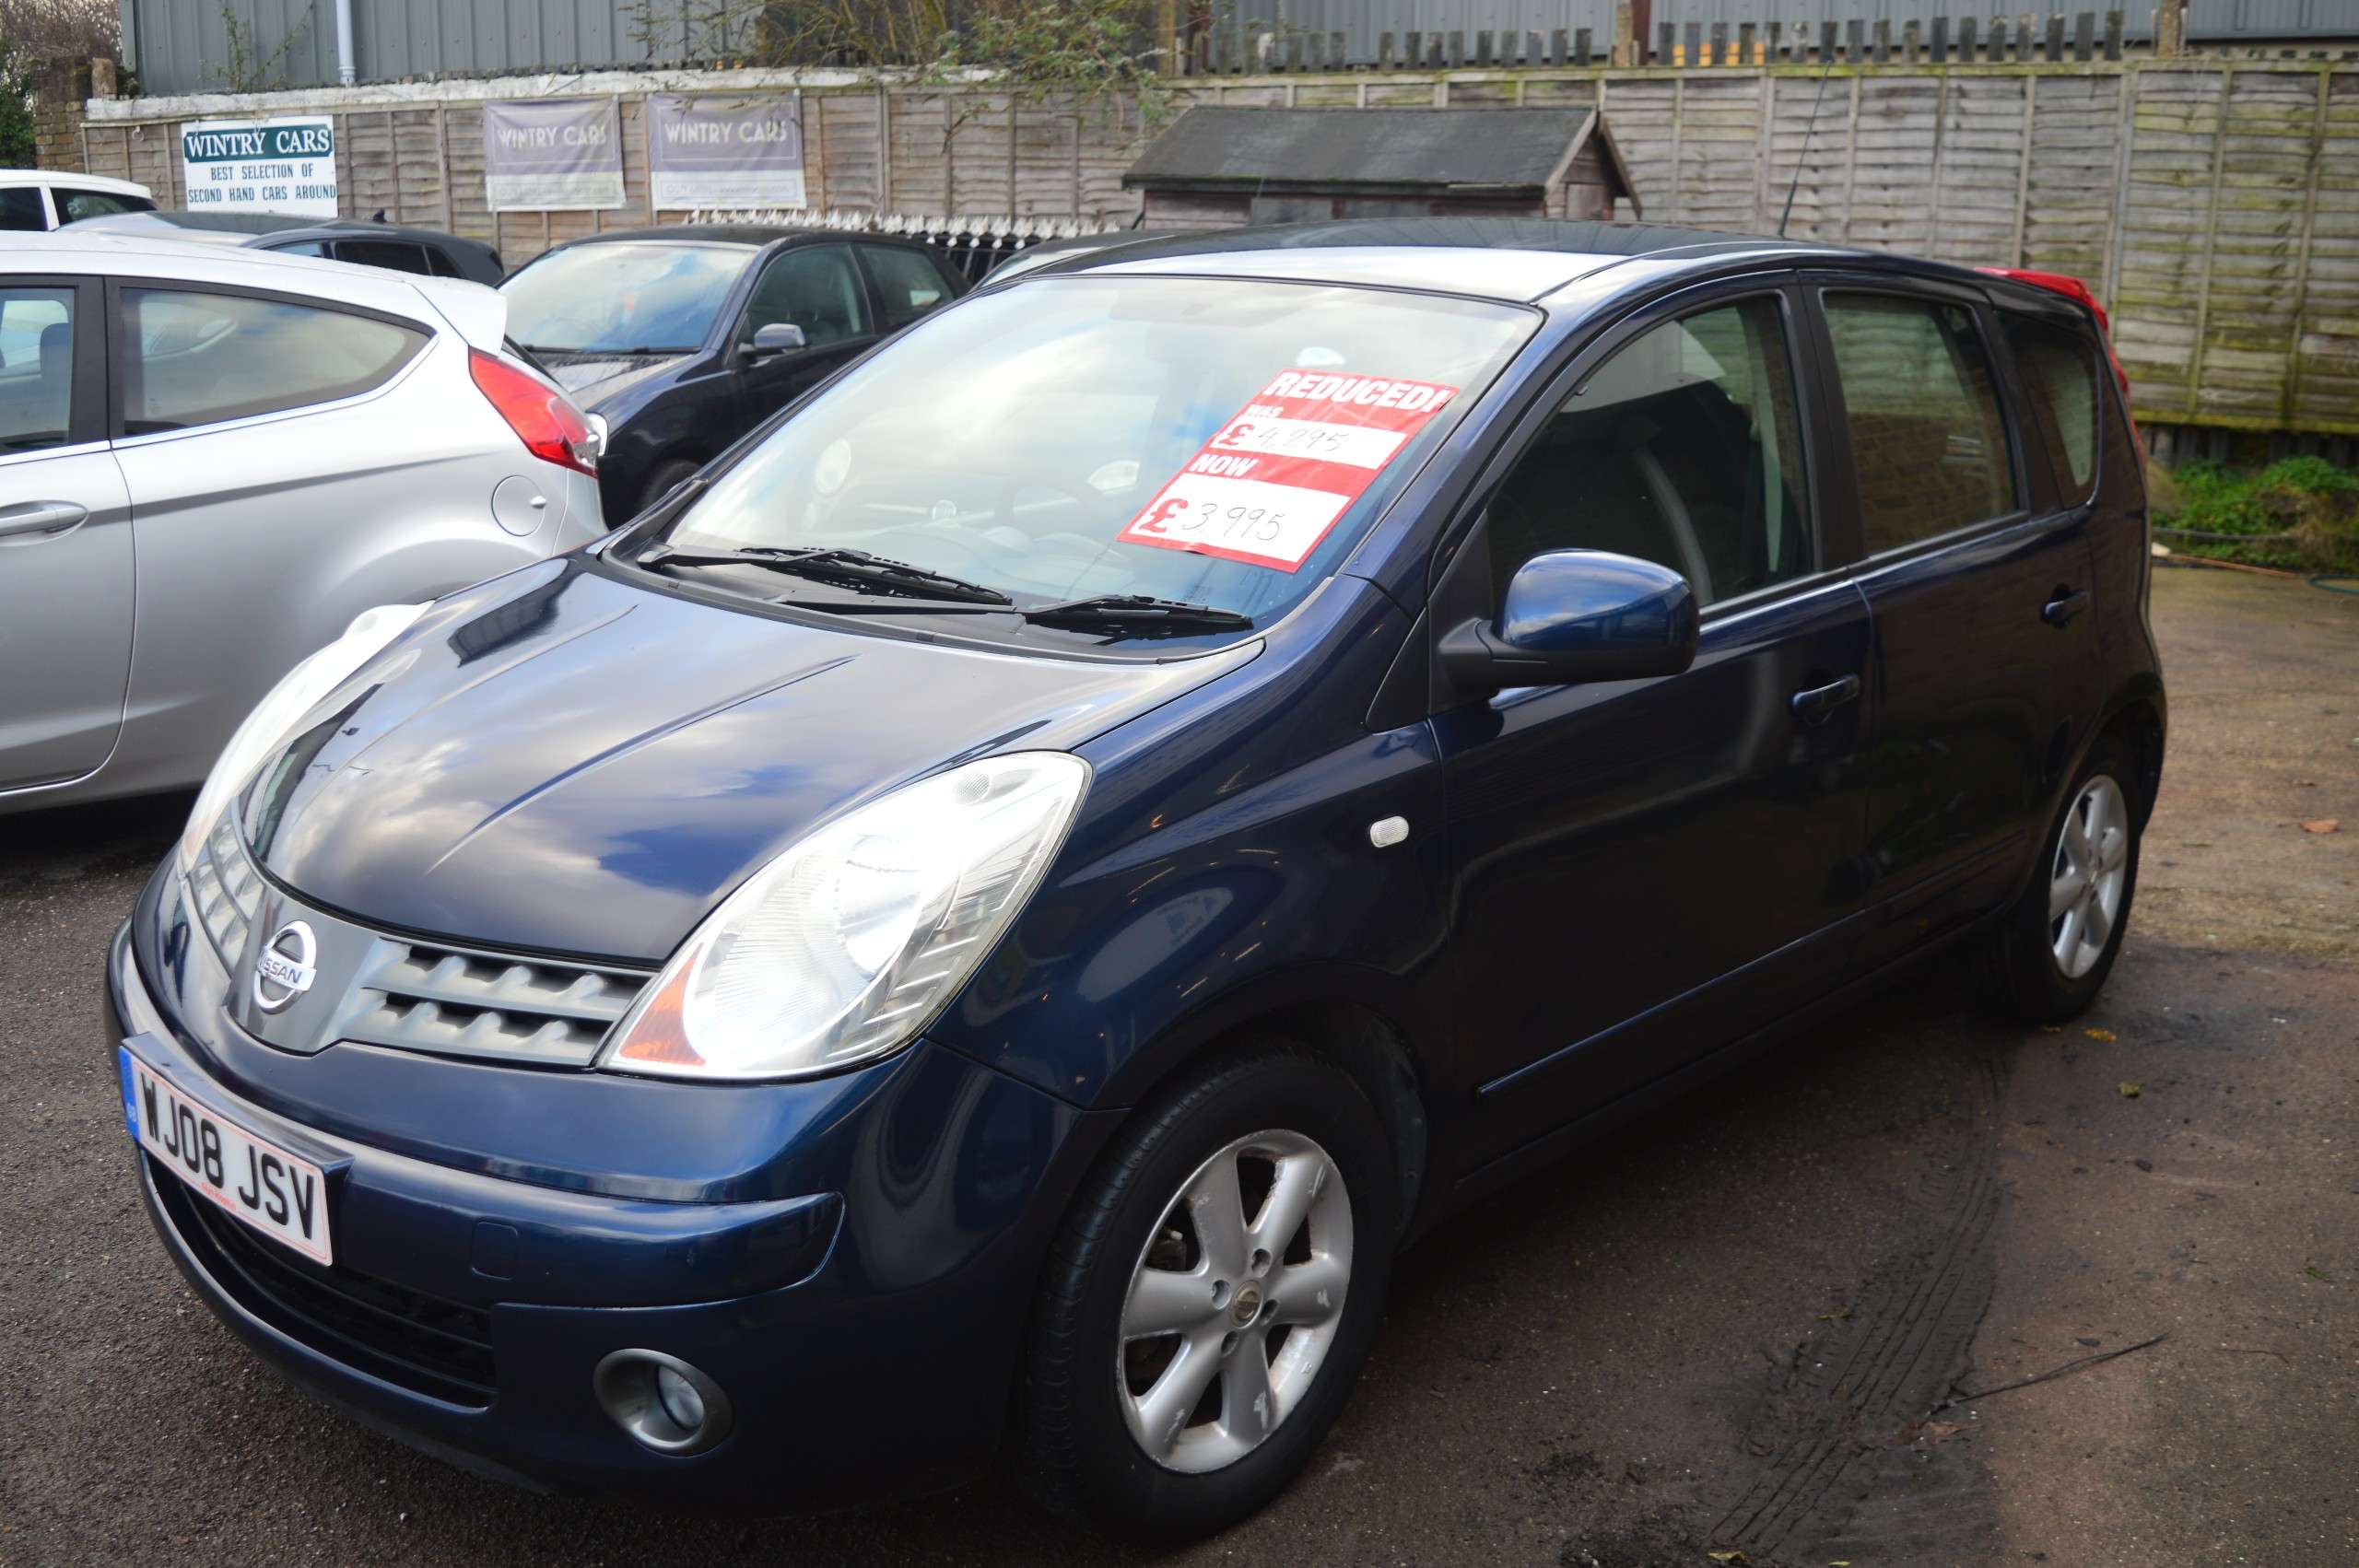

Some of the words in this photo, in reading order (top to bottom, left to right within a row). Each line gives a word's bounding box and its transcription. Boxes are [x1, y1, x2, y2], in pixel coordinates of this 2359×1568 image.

[186, 132, 266, 158] WINTRY
[276, 129, 330, 153] CARS
[497, 127, 557, 147] WINTRY
[563, 125, 607, 146] CARS
[663, 123, 734, 144] WINTRY
[739, 121, 788, 143] CARS
[210, 166, 234, 181] BEST
[241, 164, 294, 180] SELECTION
[301, 162, 314, 178] OF
[188, 189, 222, 203] SECOND
[229, 187, 254, 201] HAND
[262, 185, 288, 200] CARS
[295, 184, 336, 199] AROUND
[1262, 372, 1450, 413] REDUCED!
[1244, 404, 1283, 418] WAS
[1191, 453, 1260, 476] NOW
[238, 1144, 314, 1240] JSV
